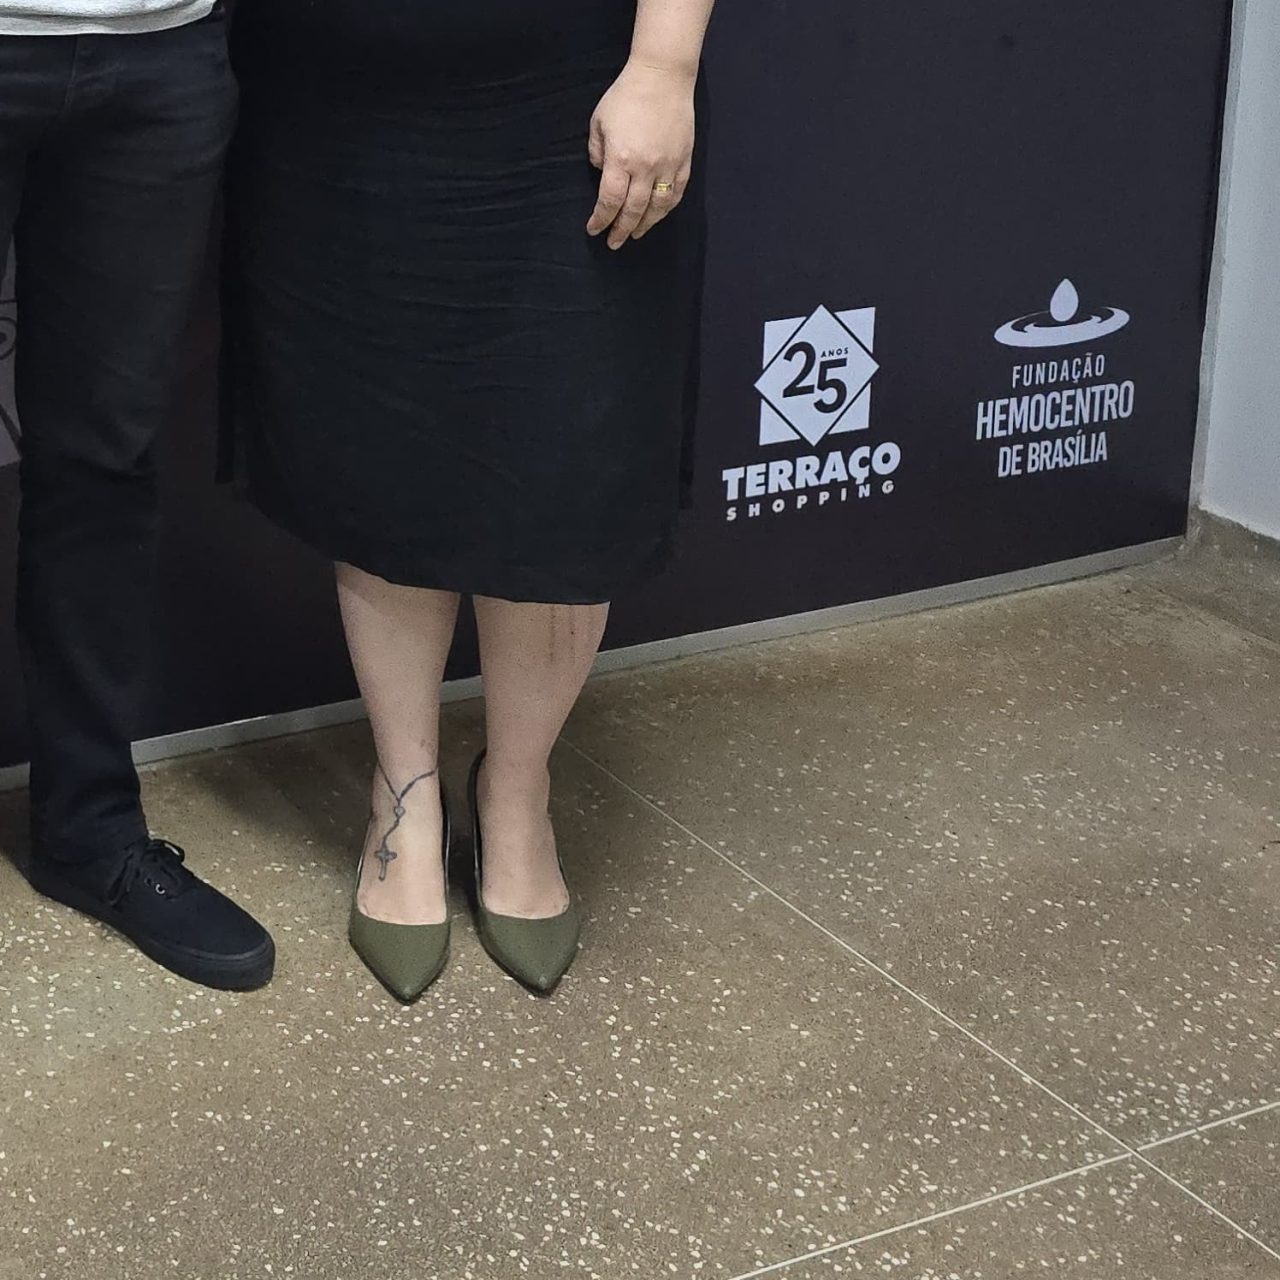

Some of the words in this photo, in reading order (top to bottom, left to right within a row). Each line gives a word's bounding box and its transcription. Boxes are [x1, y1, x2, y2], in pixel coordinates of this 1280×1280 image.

[820, 347, 849, 358] ANOS
[1012, 352, 1106, 389] FUNDAÇÃO
[782, 341, 848, 414] 25
[976, 380, 1135, 441] HEMOCENTRO
[722, 441, 901, 501] TERRAÇO
[998, 445, 1024, 478] DE
[1027, 429, 1108, 474] BRASÍLIA
[726, 480, 895, 521] SHOPPING
